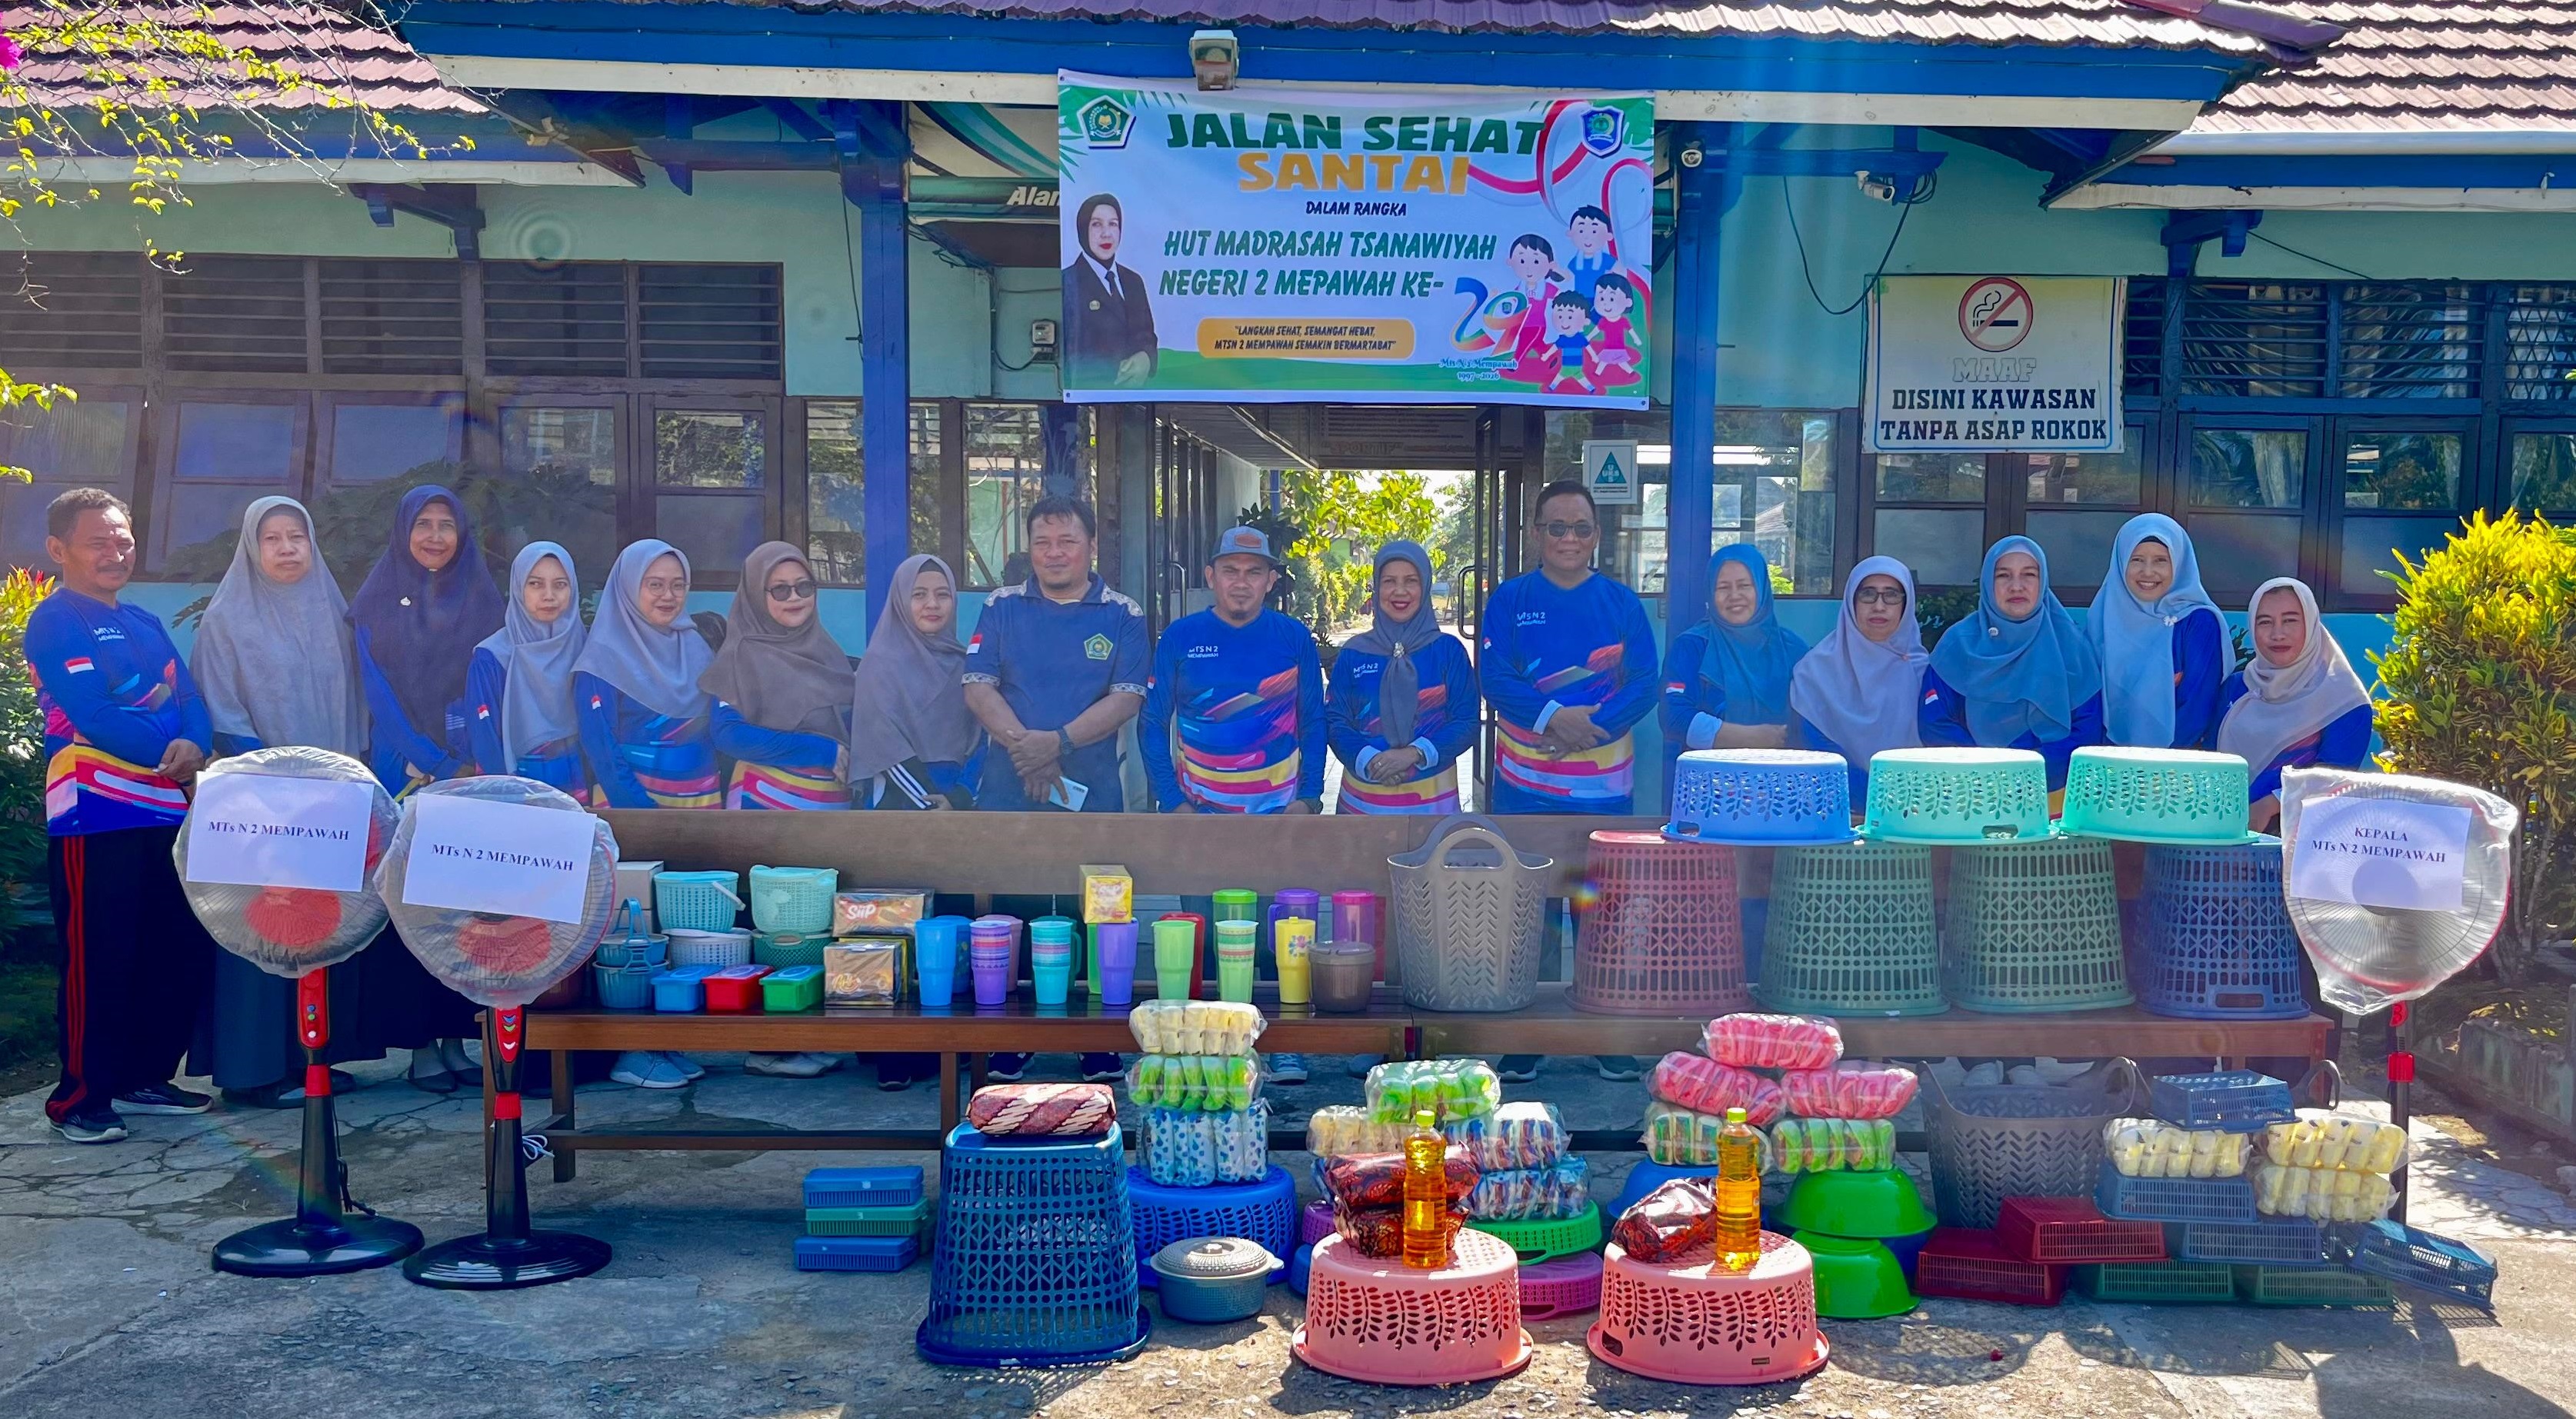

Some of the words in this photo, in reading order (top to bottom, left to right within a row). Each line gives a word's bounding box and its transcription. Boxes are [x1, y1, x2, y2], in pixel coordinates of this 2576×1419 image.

[1167, 112, 1341, 149] JALAN
[1362, 116, 1545, 155] SEHAT
[1238, 152, 1470, 195] SANTAI
[1305, 201, 1350, 216] DALAM
[1354, 202, 1407, 217] RANGKA
[1163, 230, 1211, 256] HUT
[1214, 230, 1343, 258] MADRASAH
[1349, 232, 1498, 260] TSANAWIYAH
[1159, 269, 1248, 297] NEGERI
[1254, 269, 1268, 295] 2
[1274, 270, 1397, 297] MEPAWAH
[1401, 271, 1445, 298] KE-
[1276, 325, 1302, 337] SEHAT,
[1304, 325, 1348, 336] SEMANGAT
[1348, 326, 1375, 338] HEBAT,
[1215, 339, 1238, 349] MTSN
[1239, 340, 1245, 349] 2
[1245, 340, 1293, 350] MEMPAWAH
[1295, 340, 1333, 350] SEMAKIN
[1952, 358, 2037, 382] MAAF
[1892, 389, 1966, 409] DISINI
[1971, 388, 2096, 409] KAWASAN
[1881, 421, 1958, 440] TANPA
[1964, 420, 2024, 440] ASAP
[2031, 419, 2107, 439] ROKOK
[208, 821, 235, 833] MTs
[238, 823, 248, 834] N
[251, 824, 258, 834] 2
[261, 824, 350, 841] MEMPAWAH
[2354, 827, 2408, 842] KEPALA
[431, 844, 460, 857] MTs
[462, 848, 474, 858] N
[475, 849, 483, 860] 2
[486, 851, 574, 871] MEMPAWAH
[2311, 840, 2336, 851] MTs
[2339, 842, 2349, 852] N
[2351, 844, 2358, 854] 2
[2361, 844, 2446, 863] MEMPAWAH
